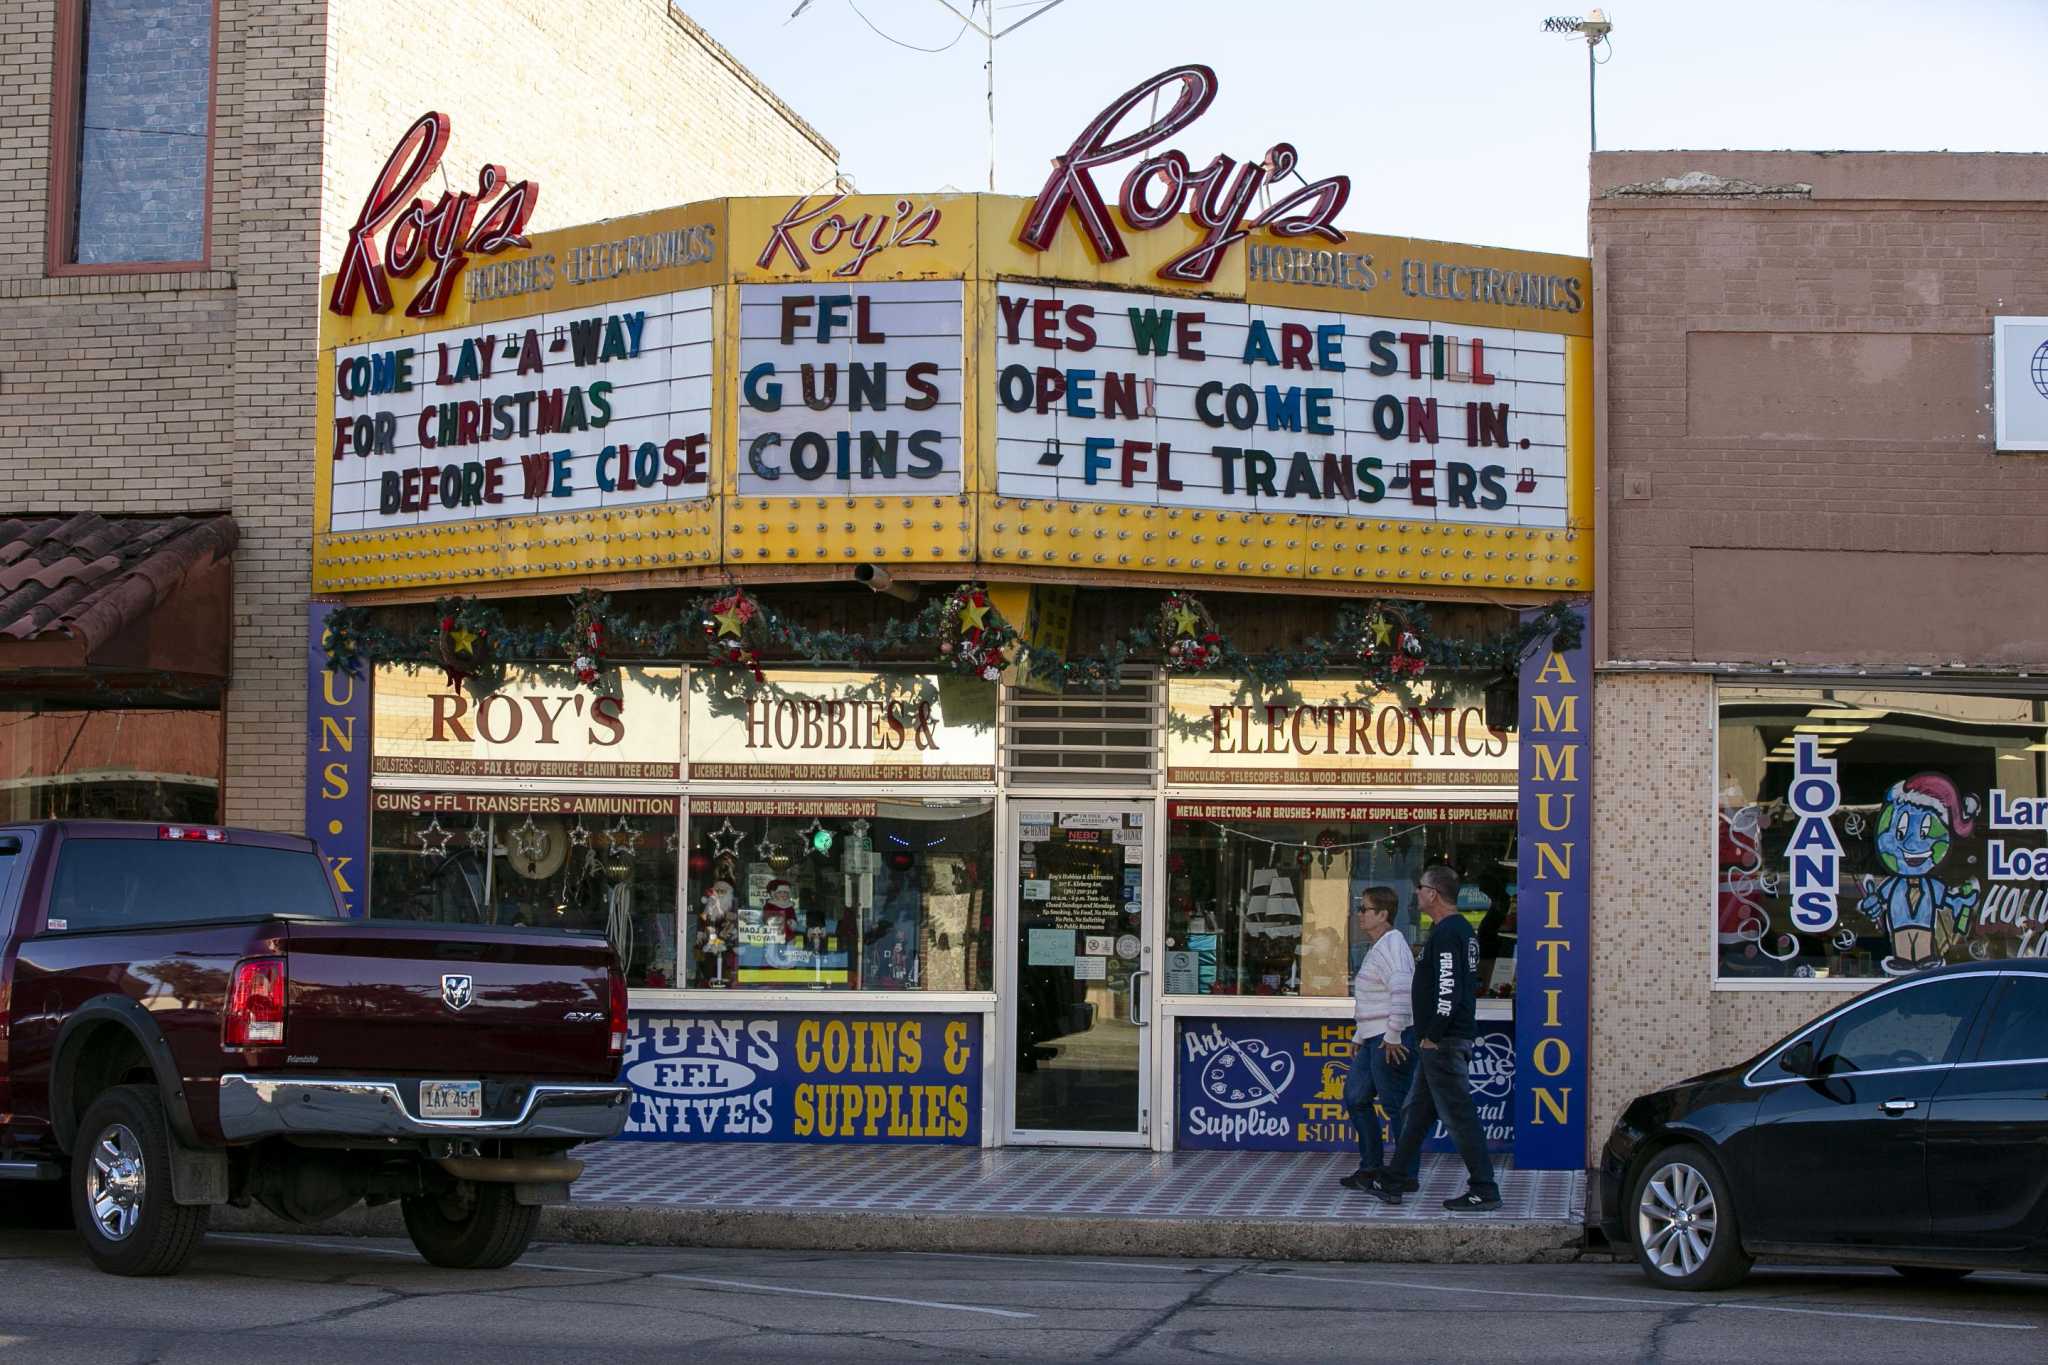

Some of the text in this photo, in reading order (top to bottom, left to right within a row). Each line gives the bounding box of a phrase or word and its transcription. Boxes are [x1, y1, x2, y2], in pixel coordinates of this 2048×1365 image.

[1018, 64, 1351, 282] Roy's
[329, 110, 539, 317] Roy's
[756, 193, 942, 277] Roy's
[1250, 244, 1585, 314] HOBBIES ELECTRONICS
[780, 295, 886, 345] FFL
[999, 295, 1495, 385] YES WE ARE STILL
[338, 347, 415, 401] COME
[743, 362, 940, 413] GUNS
[333, 381, 612, 460] FOR CHRISTMAS
[999, 363, 1530, 450] OPEN! COME ON IN.
[380, 432, 708, 516] BEFORE WE CLOSE
[748, 429, 944, 481] COINS
[1084, 437, 1183, 491] FFL
[426, 693, 1508, 758] ROY'S HOBBIES & ELECTRONICS
[376, 758, 414, 773] HOLSTERS
[418, 759, 434, 773] GUN
[435, 760, 455, 774] RUGS
[484, 761, 502, 775] FAX
[504, 761, 512, 775] &
[514, 762, 538, 776] COPY
[541, 762, 578, 776] SERVICE
[583, 763, 616, 777] LEANIN
[620, 764, 641, 777] TREE
[644, 764, 673, 778] CARDS
[694, 765, 991, 780] LICENSE PLATE COLLECTION OLD PICS OF KINGSVILLE GIFTS DIE CAST COLLECTIBLES
[1175, 770, 1225, 783] BINOCULARS
[1230, 771, 1279, 783] TELESCOPES
[1284, 771, 1310, 783] BALSA
[1312, 772, 1336, 783] WOOD
[1341, 772, 1372, 783] KNIVES
[1375, 772, 1402, 784] MAGIC
[1404, 772, 1422, 784] KITS
[1426, 772, 1446, 784] PINE
[1449, 772, 1470, 784] CARS
[1475, 772, 1498, 784] WOOD
[377, 794, 673, 814] GUNS FFL TRANSFERS AMMUNITION
[690, 800, 711, 814] MODEL
[713, 801, 744, 814] RAILROAD
[745, 801, 774, 814] SUPPLIES
[777, 801, 795, 815] KITES
[798, 802, 823, 815] PLASTIC
[824, 802, 849, 815] MODELS
[1176, 805, 1204, 817] METAL
[1205, 806, 1252, 818] DETECTORS
[1256, 806, 1271, 818] AIR
[1273, 807, 1311, 819] BRUSHES
[1316, 807, 1346, 819] PAINTS
[1350, 807, 1367, 819] ART
[1369, 807, 1408, 820] SUPPLIES
[1412, 808, 1438, 820] COINS
[1439, 808, 1447, 820] &
[1448, 808, 1487, 820] SUPPLIES
[1489, 809, 1513, 821] MARY
[1068, 831, 1100, 840] NEBO
[1788, 738, 1841, 929] LOANS
[1530, 651, 1579, 1126] AMMUNITION
[1436, 999, 1452, 1017] JOE
[794, 1019, 971, 1075] COINS &
[1185, 1022, 1229, 1062] Art
[453, 1091, 475, 1108] 454
[793, 1083, 968, 1137] SUPPLIES
[1188, 1106, 1290, 1142] Supplies
